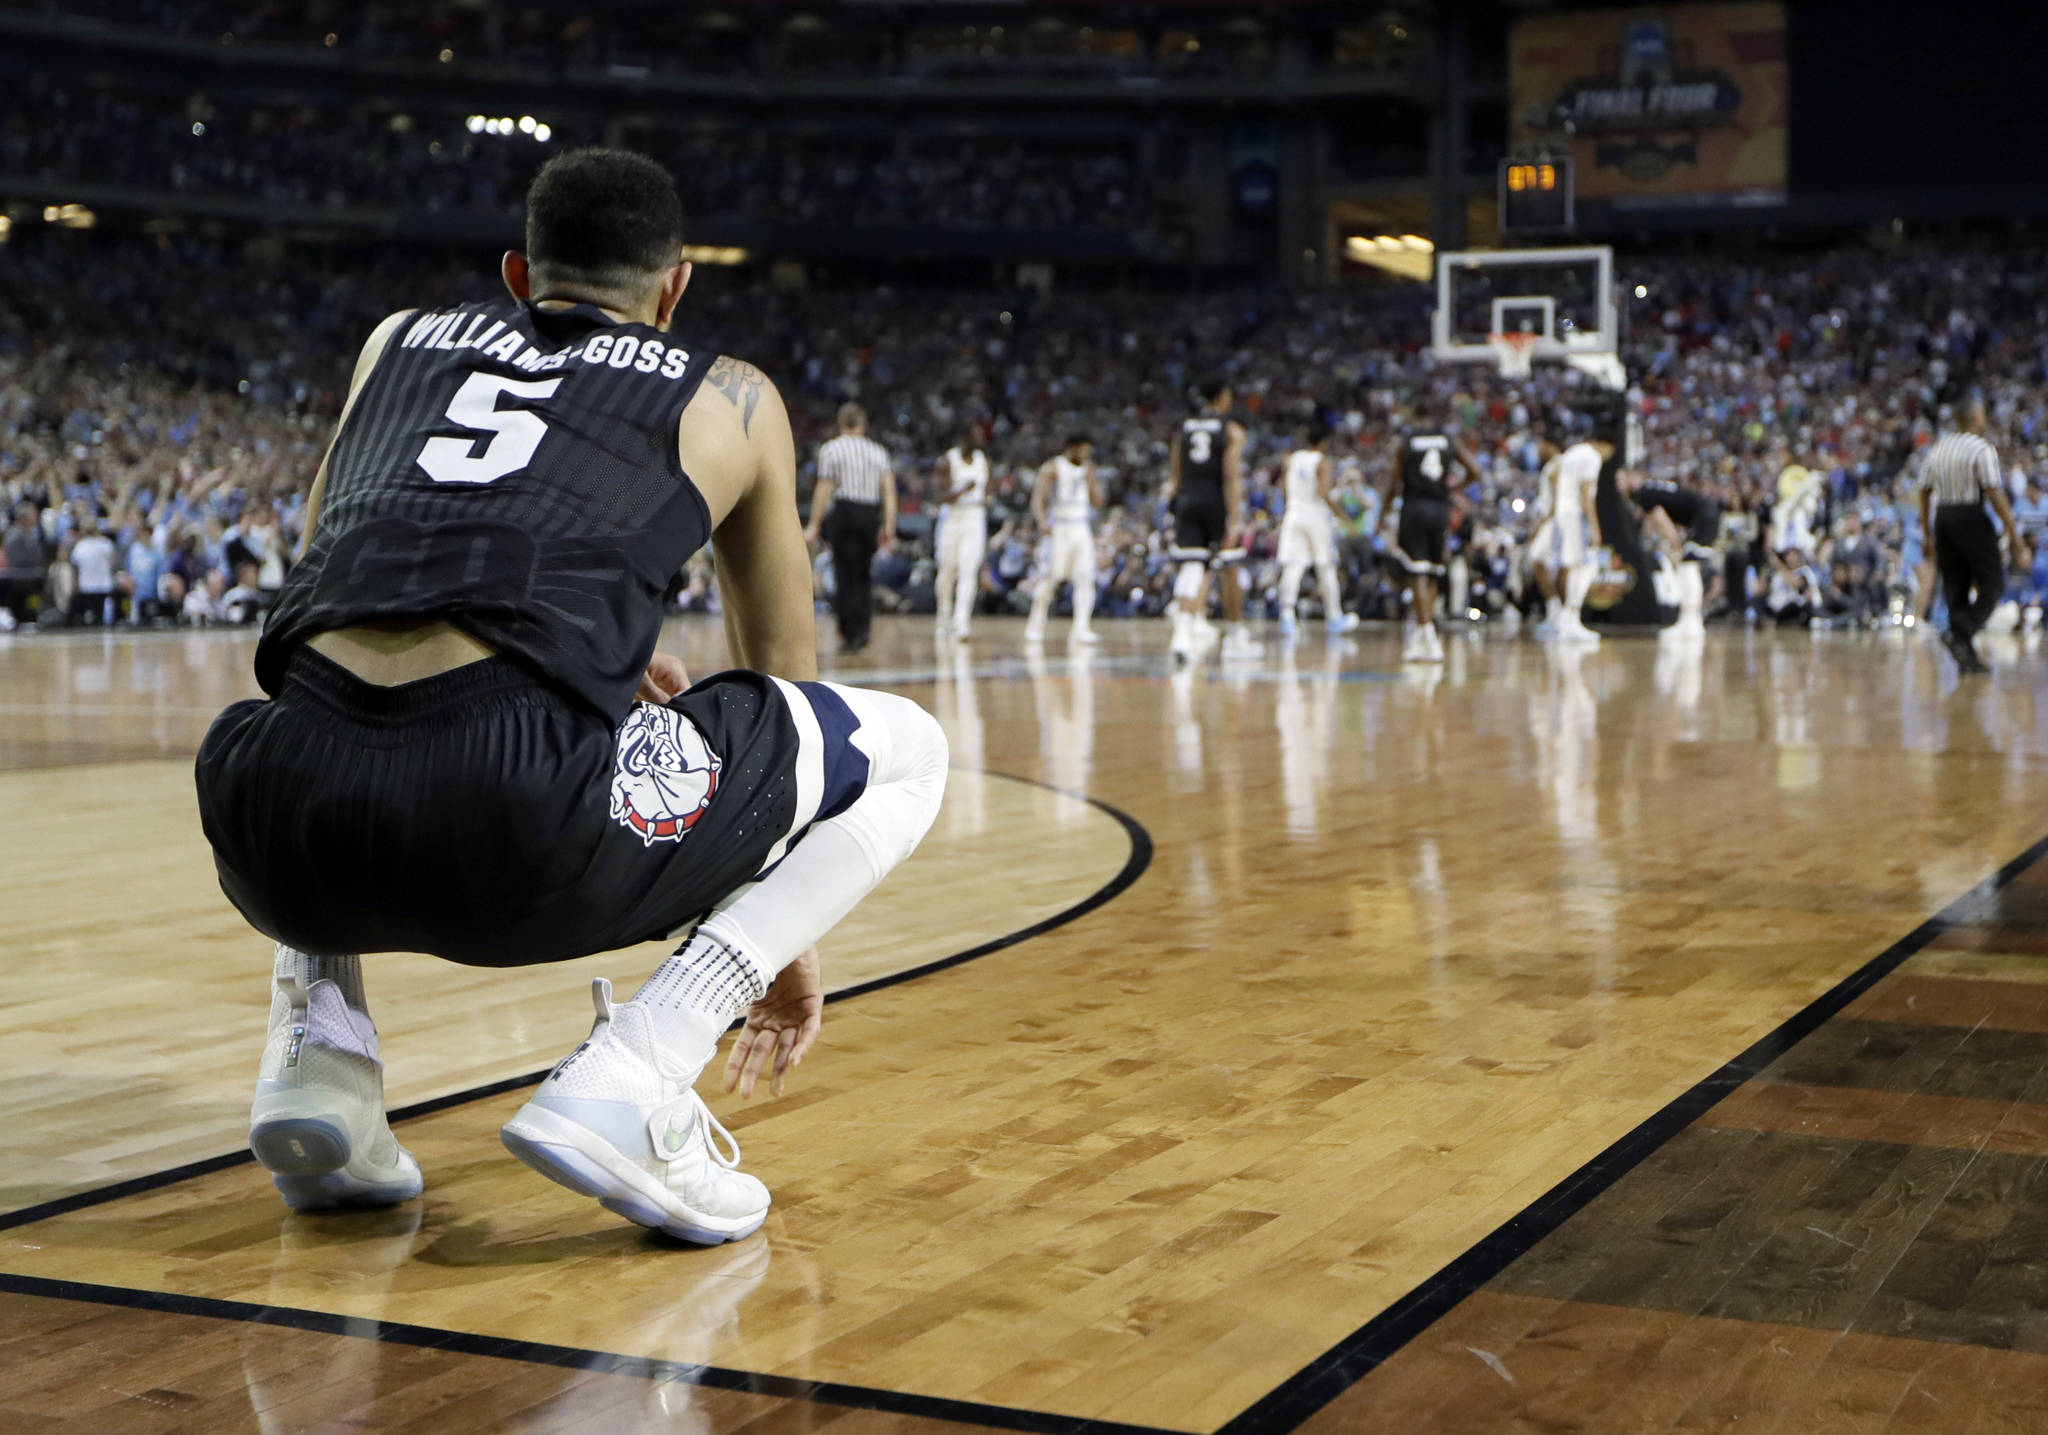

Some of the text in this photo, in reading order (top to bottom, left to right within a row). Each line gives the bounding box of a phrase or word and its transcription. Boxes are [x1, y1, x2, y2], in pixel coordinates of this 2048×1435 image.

[416, 371, 564, 484] 5
[1189, 431, 1211, 463] 3
[1420, 449, 1443, 480] 4
